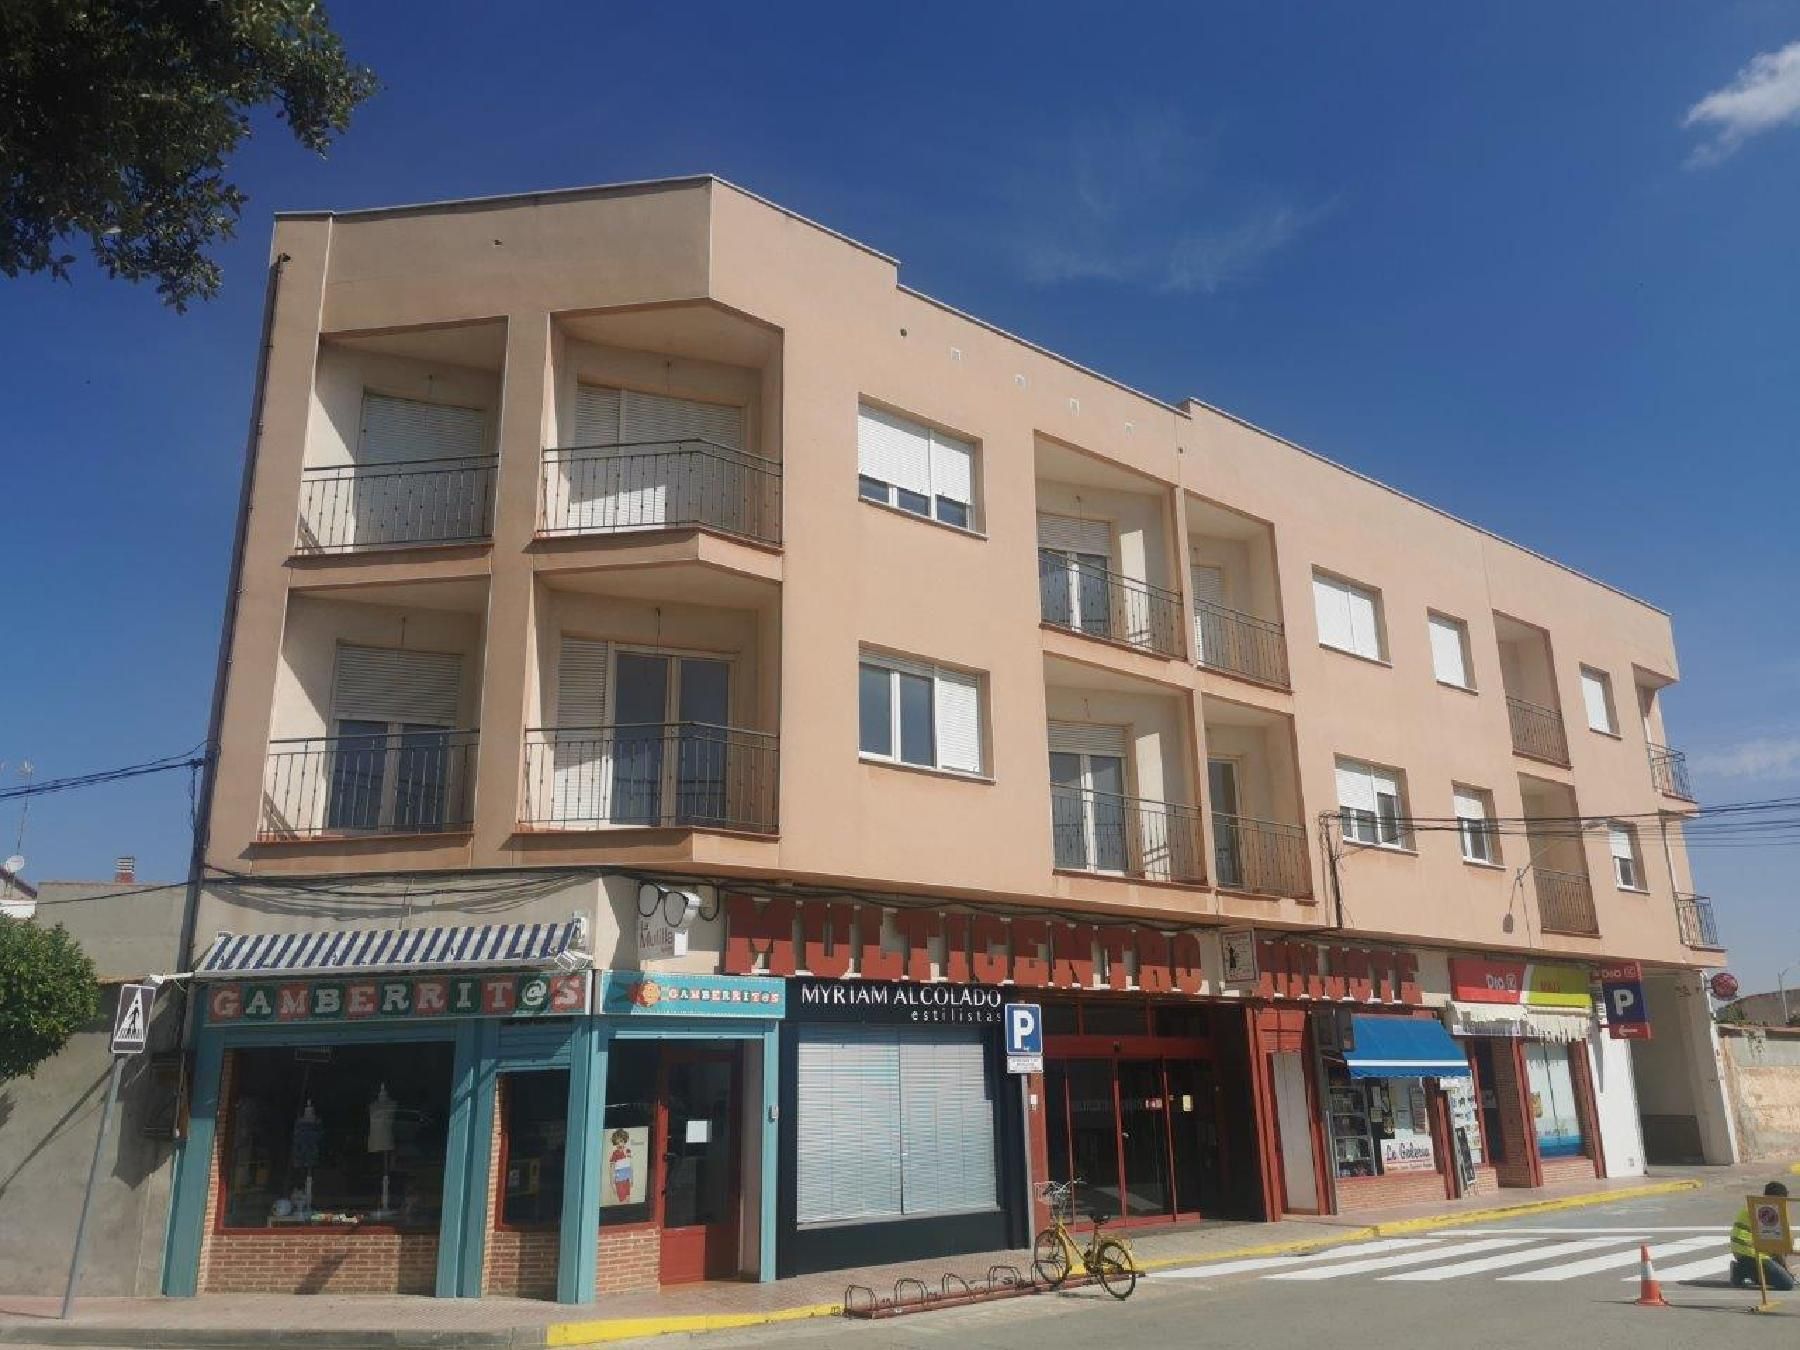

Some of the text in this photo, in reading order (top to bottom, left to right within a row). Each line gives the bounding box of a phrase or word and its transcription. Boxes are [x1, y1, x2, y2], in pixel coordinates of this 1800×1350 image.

[725, 895, 1202, 994] MULTICENTRO
[802, 983, 1001, 1008] MYRIAM ALCOLADO
[1613, 989, 1634, 1016] P
[910, 1007, 1001, 1022] estilistas
[1013, 1010, 1035, 1049] P
